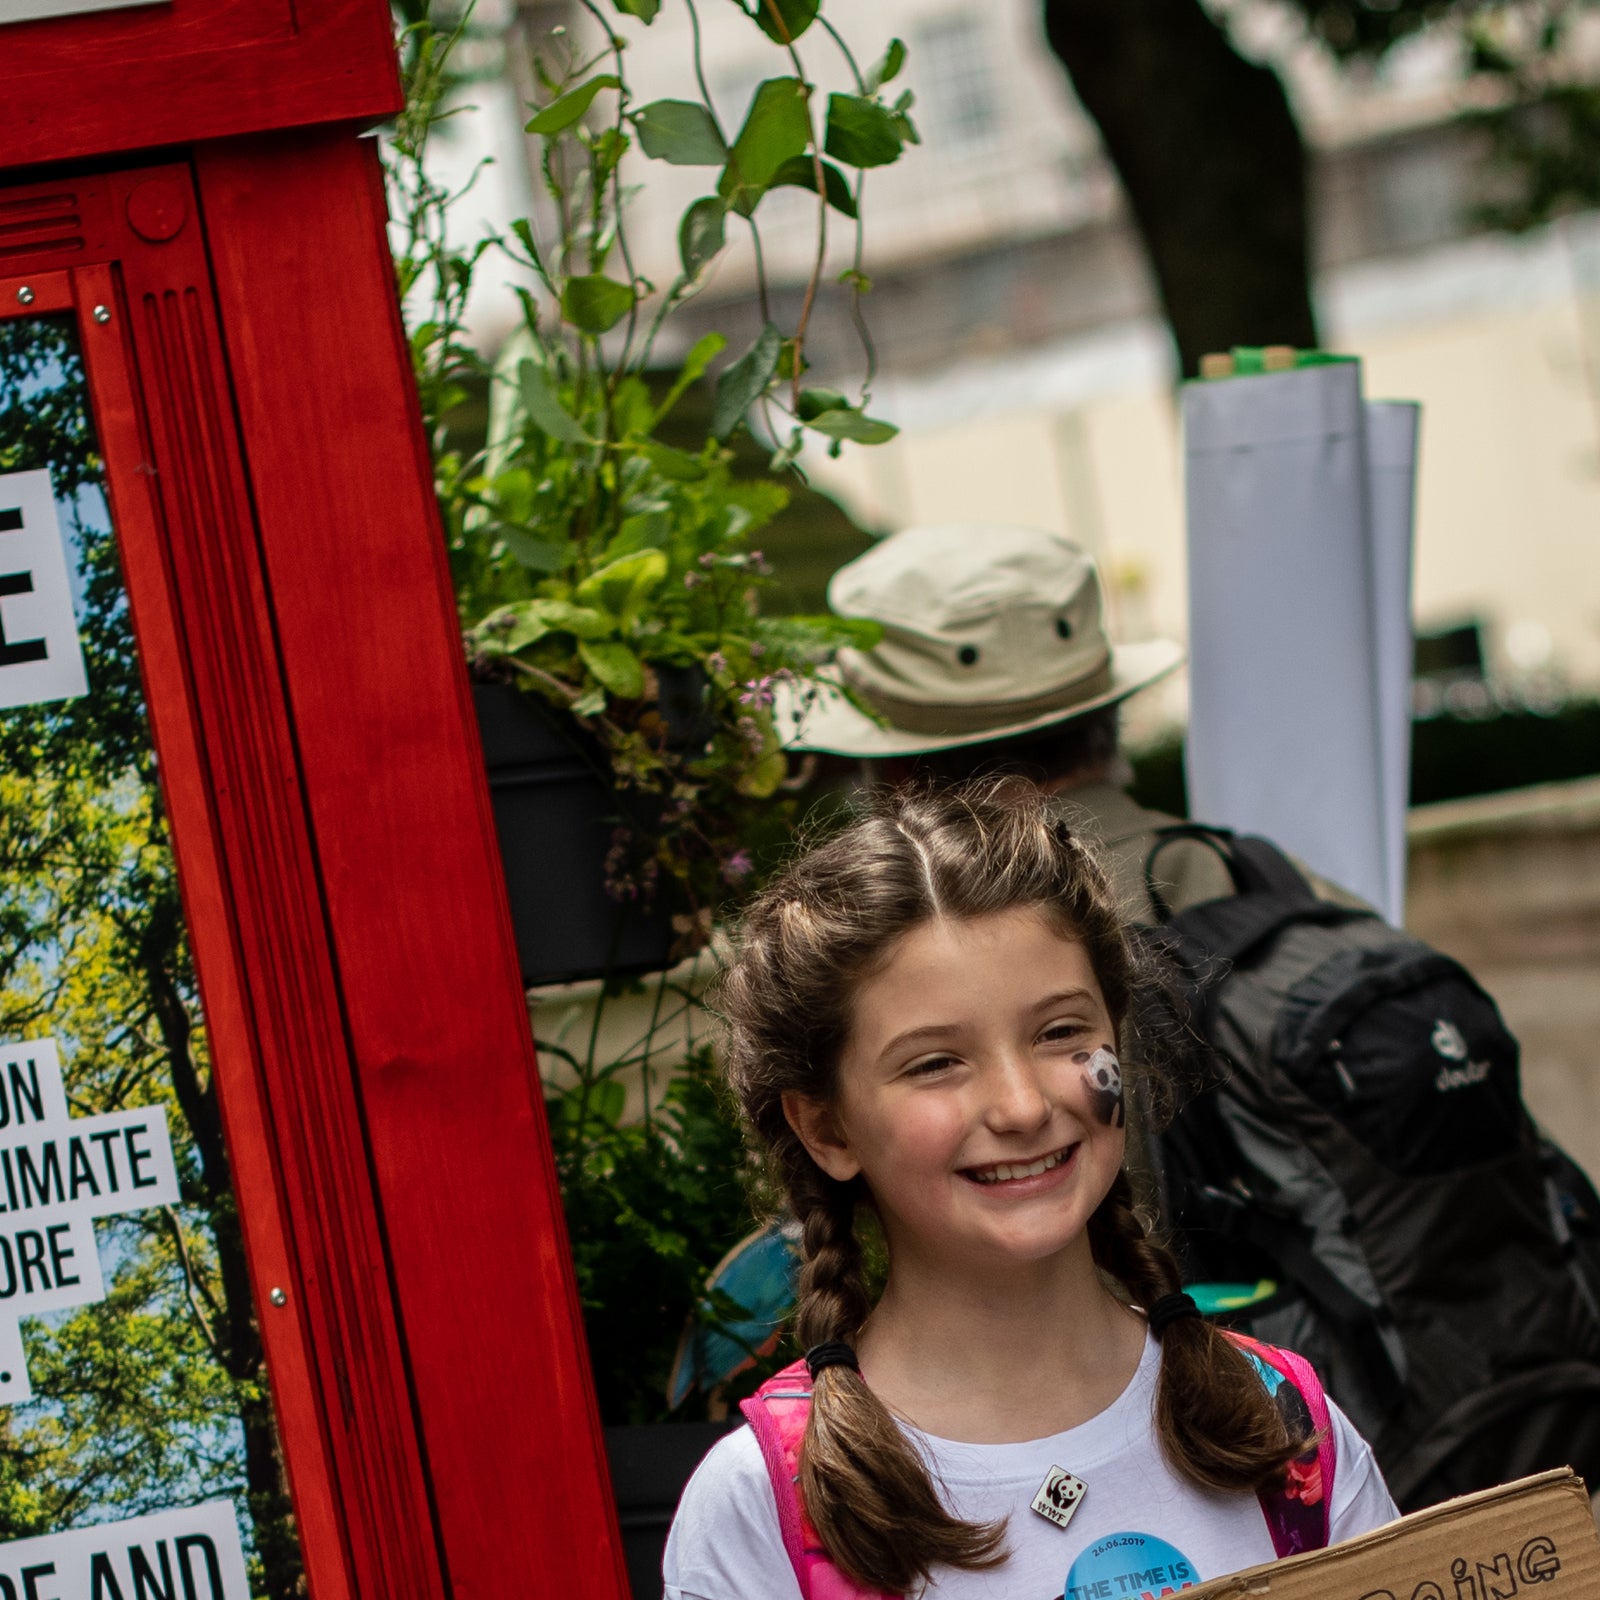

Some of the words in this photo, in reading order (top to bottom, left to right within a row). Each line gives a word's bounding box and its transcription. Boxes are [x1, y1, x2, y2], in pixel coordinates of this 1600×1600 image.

[1037, 1501, 1067, 1522] WWF
[1092, 1537, 1145, 1557] 26.06.2019
[1114, 1566, 1167, 1593] TIME
[1168, 1562, 1190, 1581] IS
